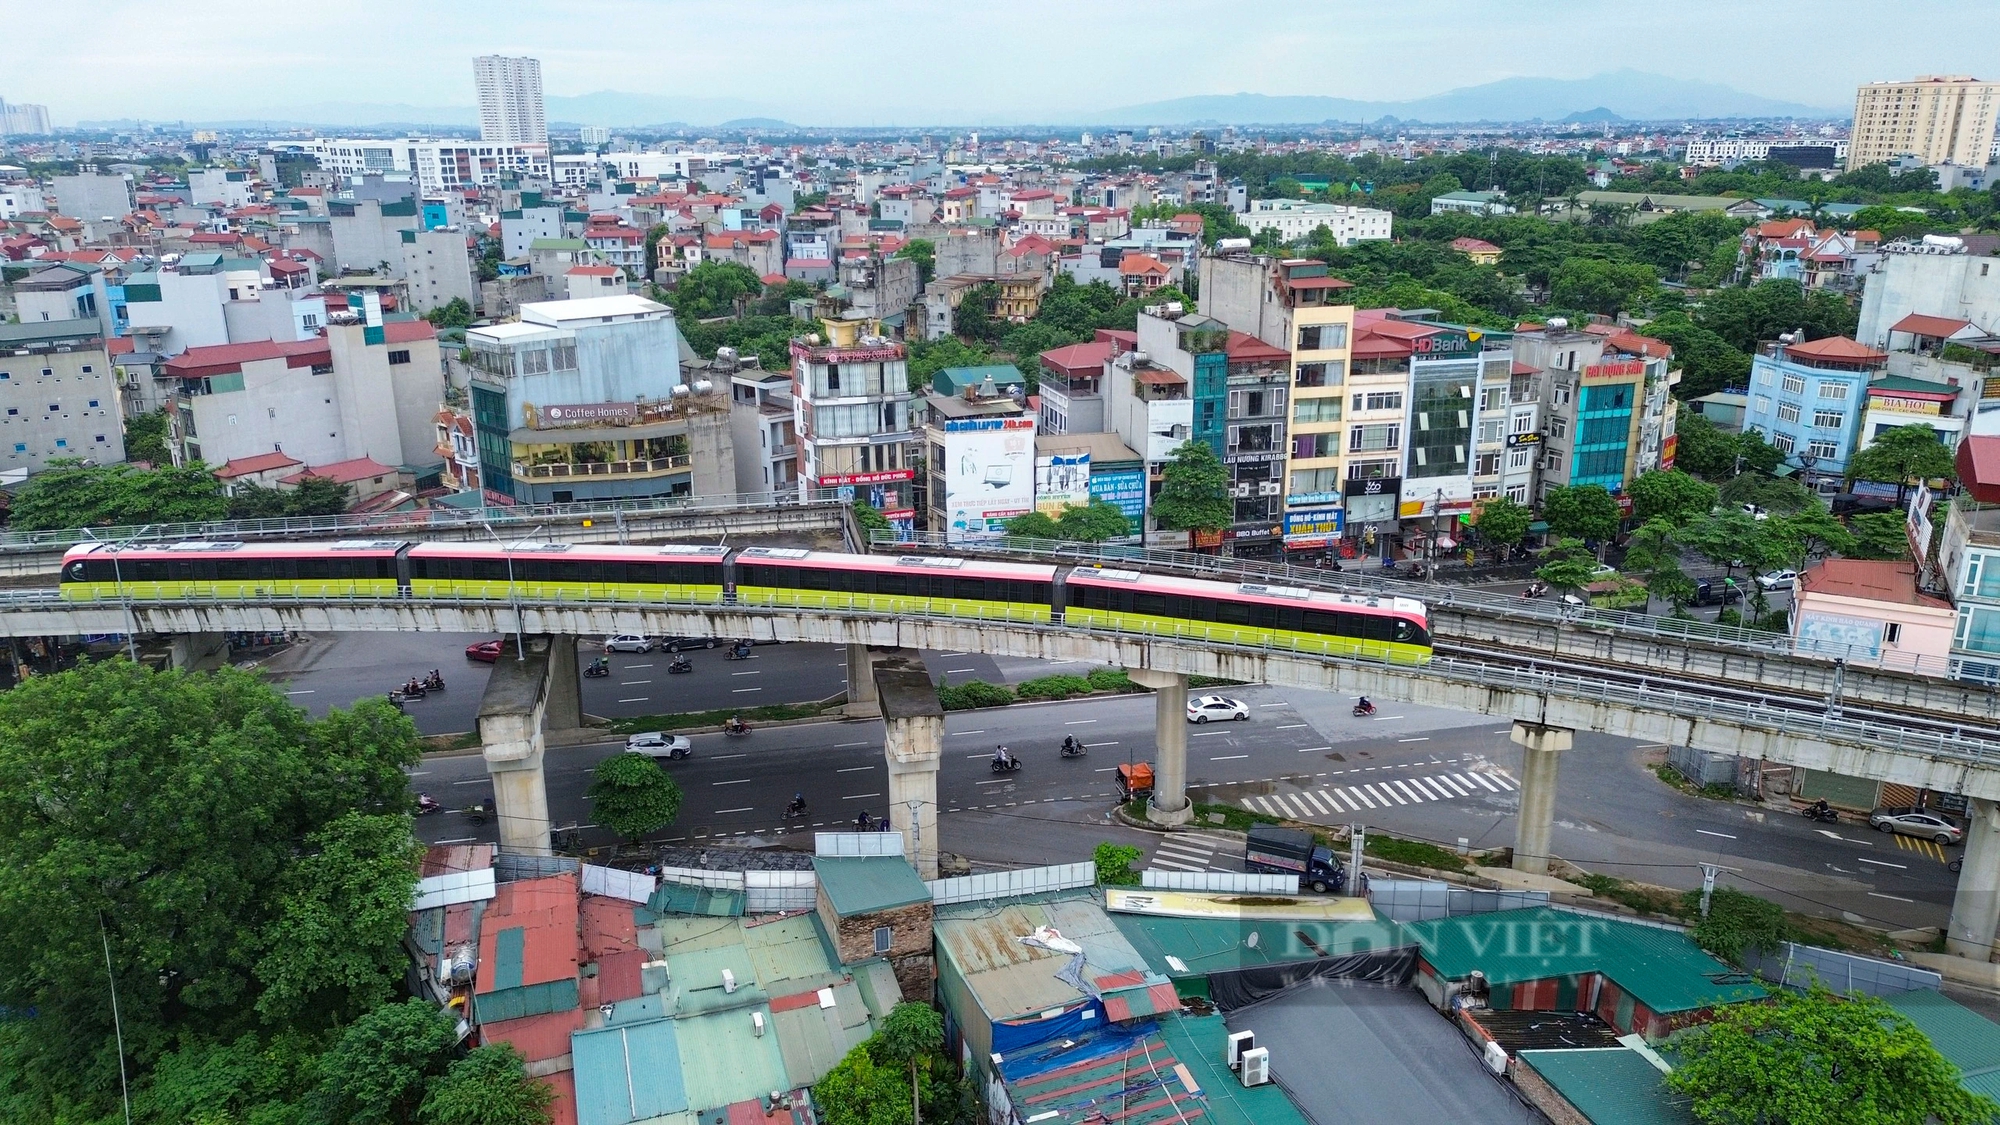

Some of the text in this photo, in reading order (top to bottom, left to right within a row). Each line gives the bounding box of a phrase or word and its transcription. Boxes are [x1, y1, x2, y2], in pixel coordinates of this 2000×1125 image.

[1411, 336, 1468, 353] HDBank
[871, 347, 895, 359] COFFEE
[1883, 398, 1902, 408] BIA
[565, 407, 629, 418] Coffee Homes
[978, 418, 1003, 430] LAPTOP
[1003, 419, 1033, 429] 24h.com
[1091, 485, 1103, 493] MUA
[1236, 530, 1250, 538] BBQ
[1251, 528, 1270, 537] Buffet
